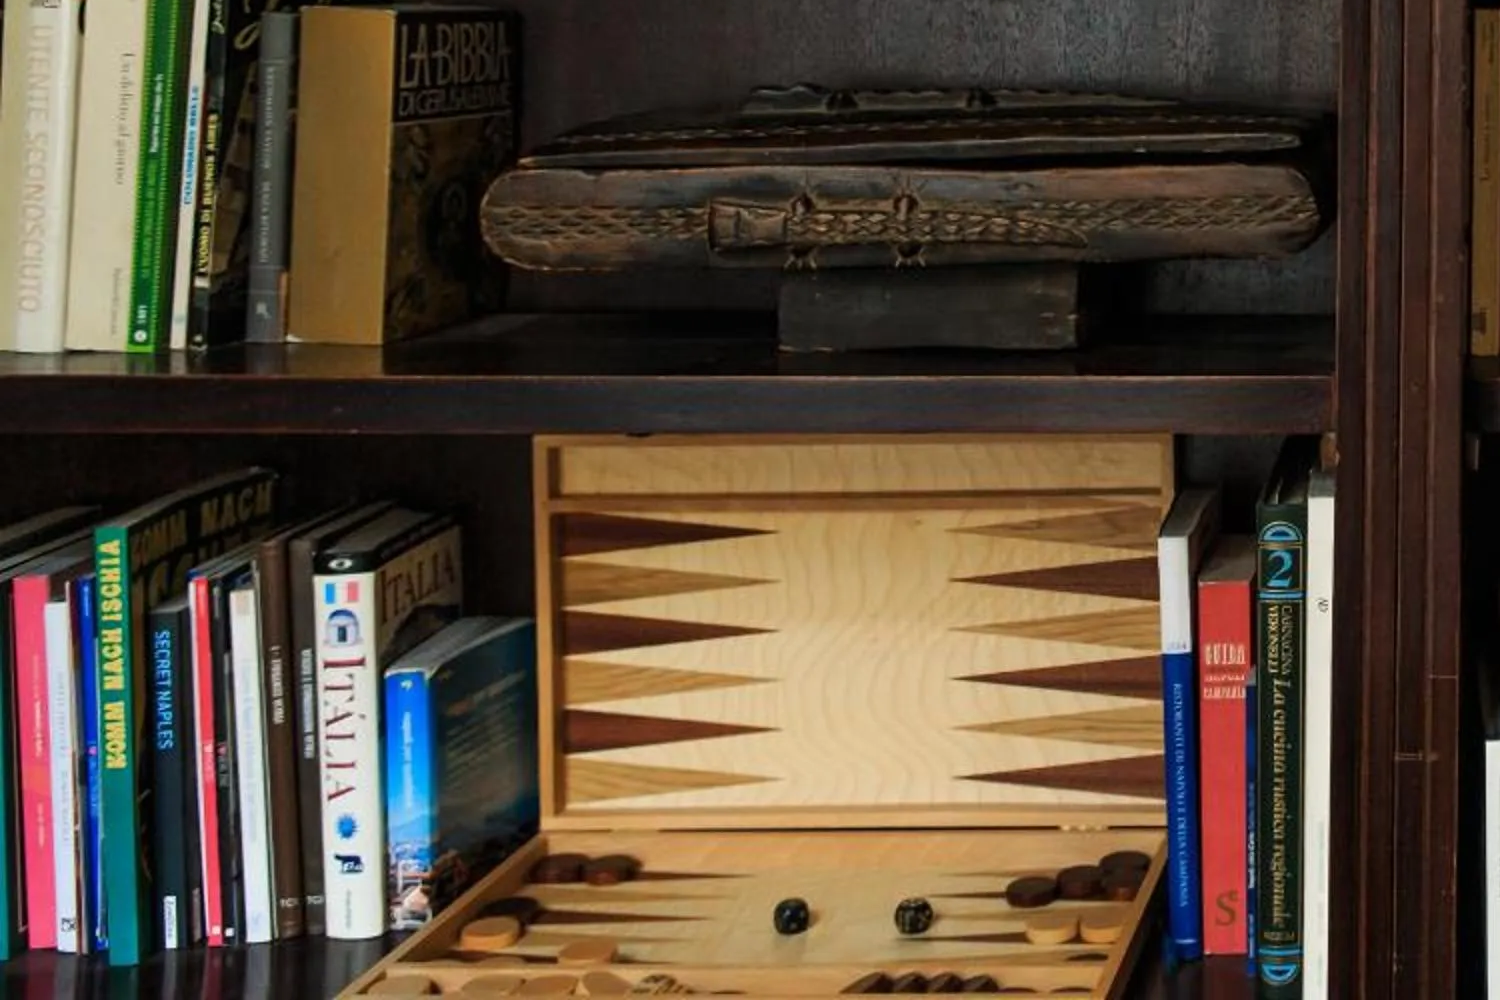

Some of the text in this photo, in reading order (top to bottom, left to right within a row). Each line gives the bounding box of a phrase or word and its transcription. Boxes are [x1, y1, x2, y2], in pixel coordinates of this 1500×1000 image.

[17, 24, 53, 314] UTENTE SCONOSCIUTO
[1268, 551, 1296, 587] 2
[97, 539, 128, 769] KOMM NACH ISCHIA
[1267, 604, 1280, 673] VERONELLI
[1280, 604, 1294, 675] CARNACINA
[154, 630, 174, 750] SECRET NAPLES
[1173, 683, 1188, 747] RISTORANTI
[1174, 750, 1188, 763] DI
[1175, 767, 1188, 806] NAPOLI
[1176, 818, 1189, 846] DELLA
[1269, 678, 1291, 928] La cucina rustica regionale
[1177, 850, 1190, 907] CAMPANIA
